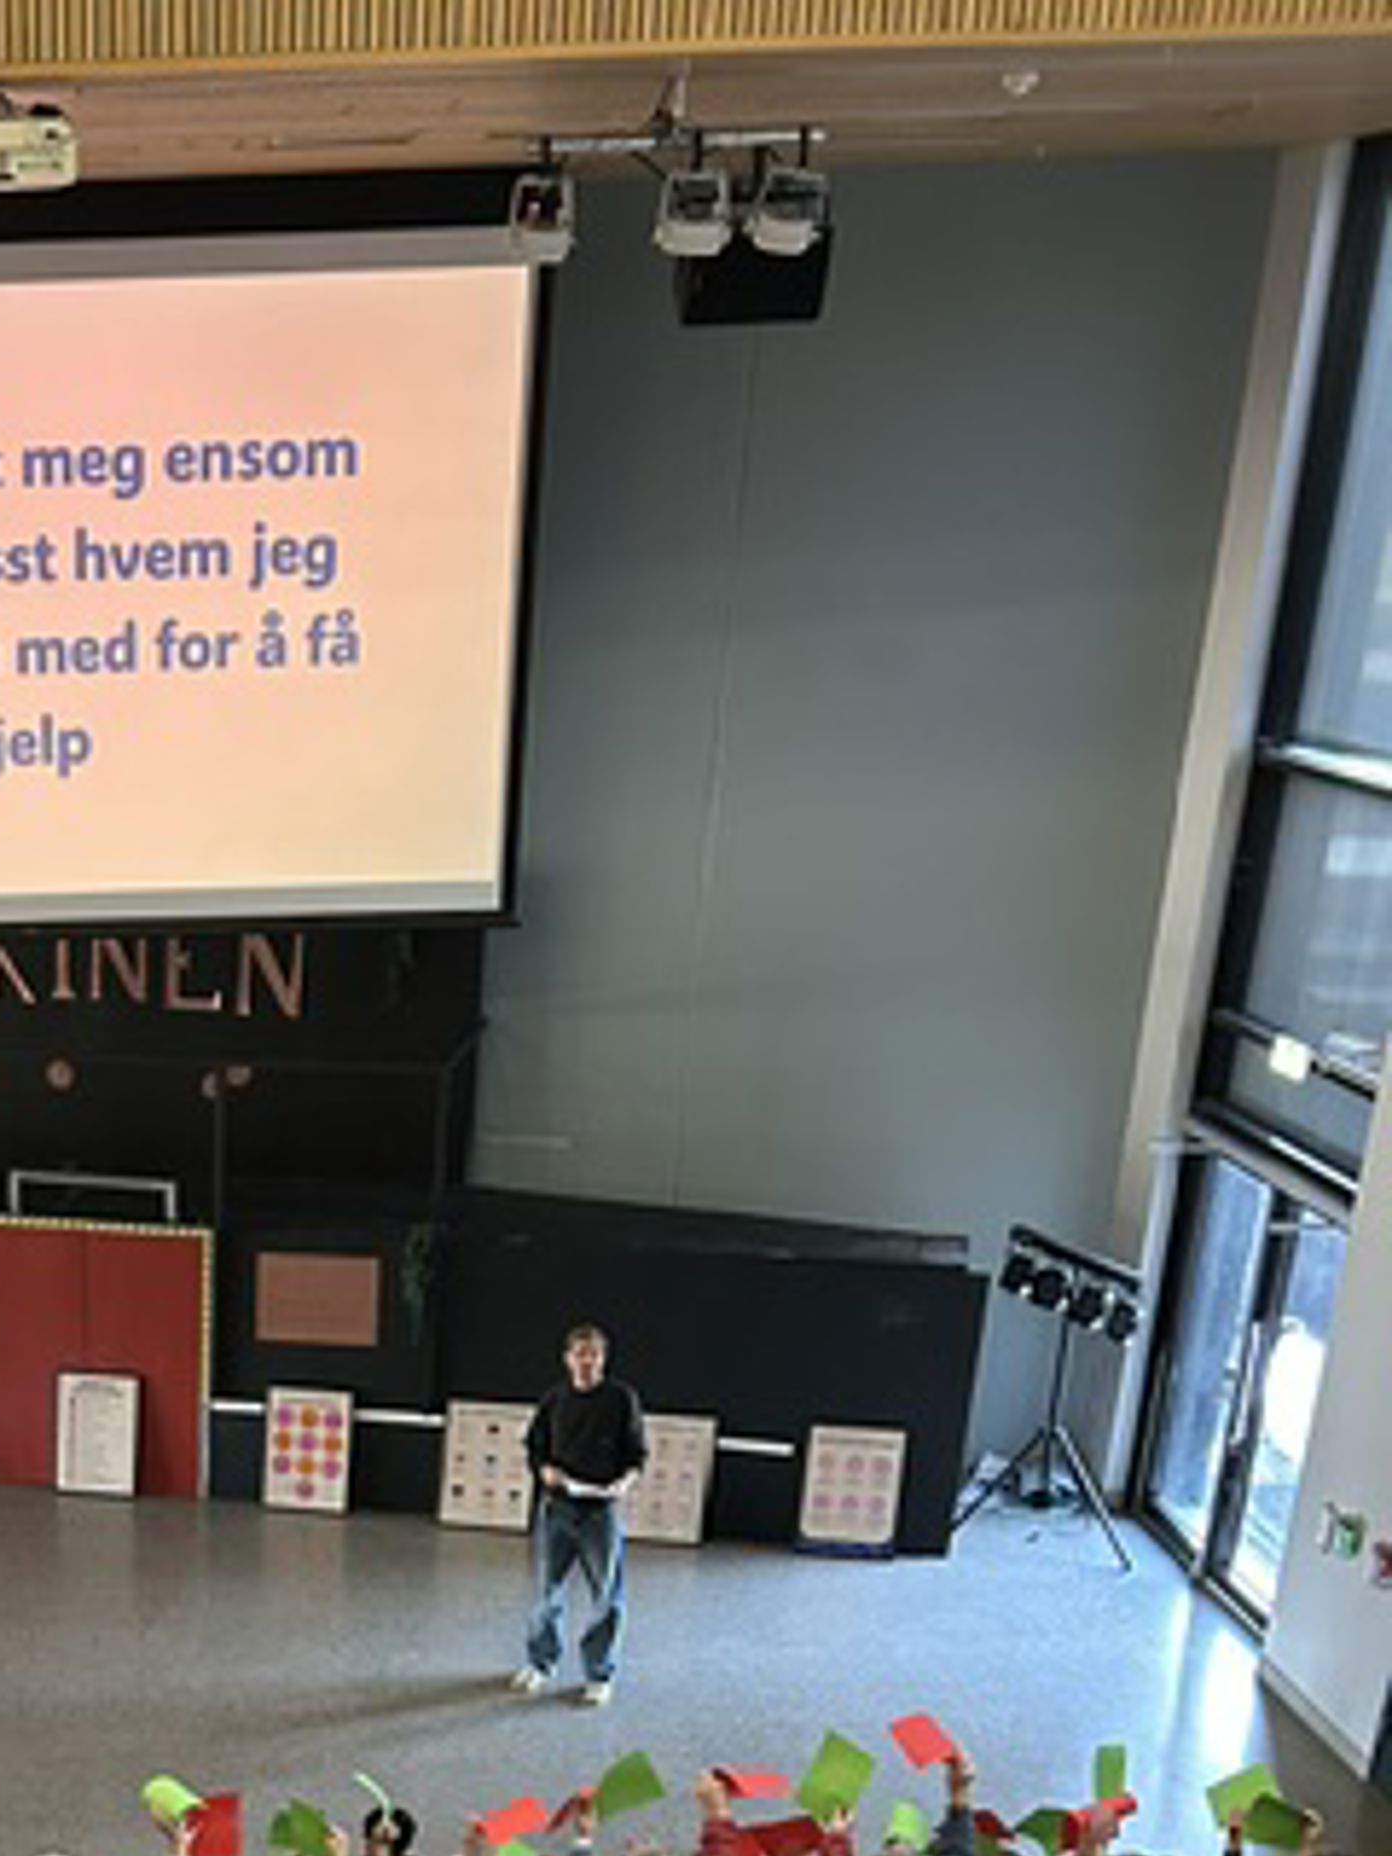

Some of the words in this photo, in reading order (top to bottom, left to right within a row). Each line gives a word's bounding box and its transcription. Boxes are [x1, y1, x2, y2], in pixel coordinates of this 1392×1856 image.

[21, 444, 146, 502] meg
[163, 438, 359, 485] ensom
[74, 526, 232, 583] hvem
[247, 520, 338, 592] jeg
[16, 622, 138, 676] med
[154, 616, 240, 673] for
[254, 609, 288, 670] å
[305, 607, 361, 668] få
